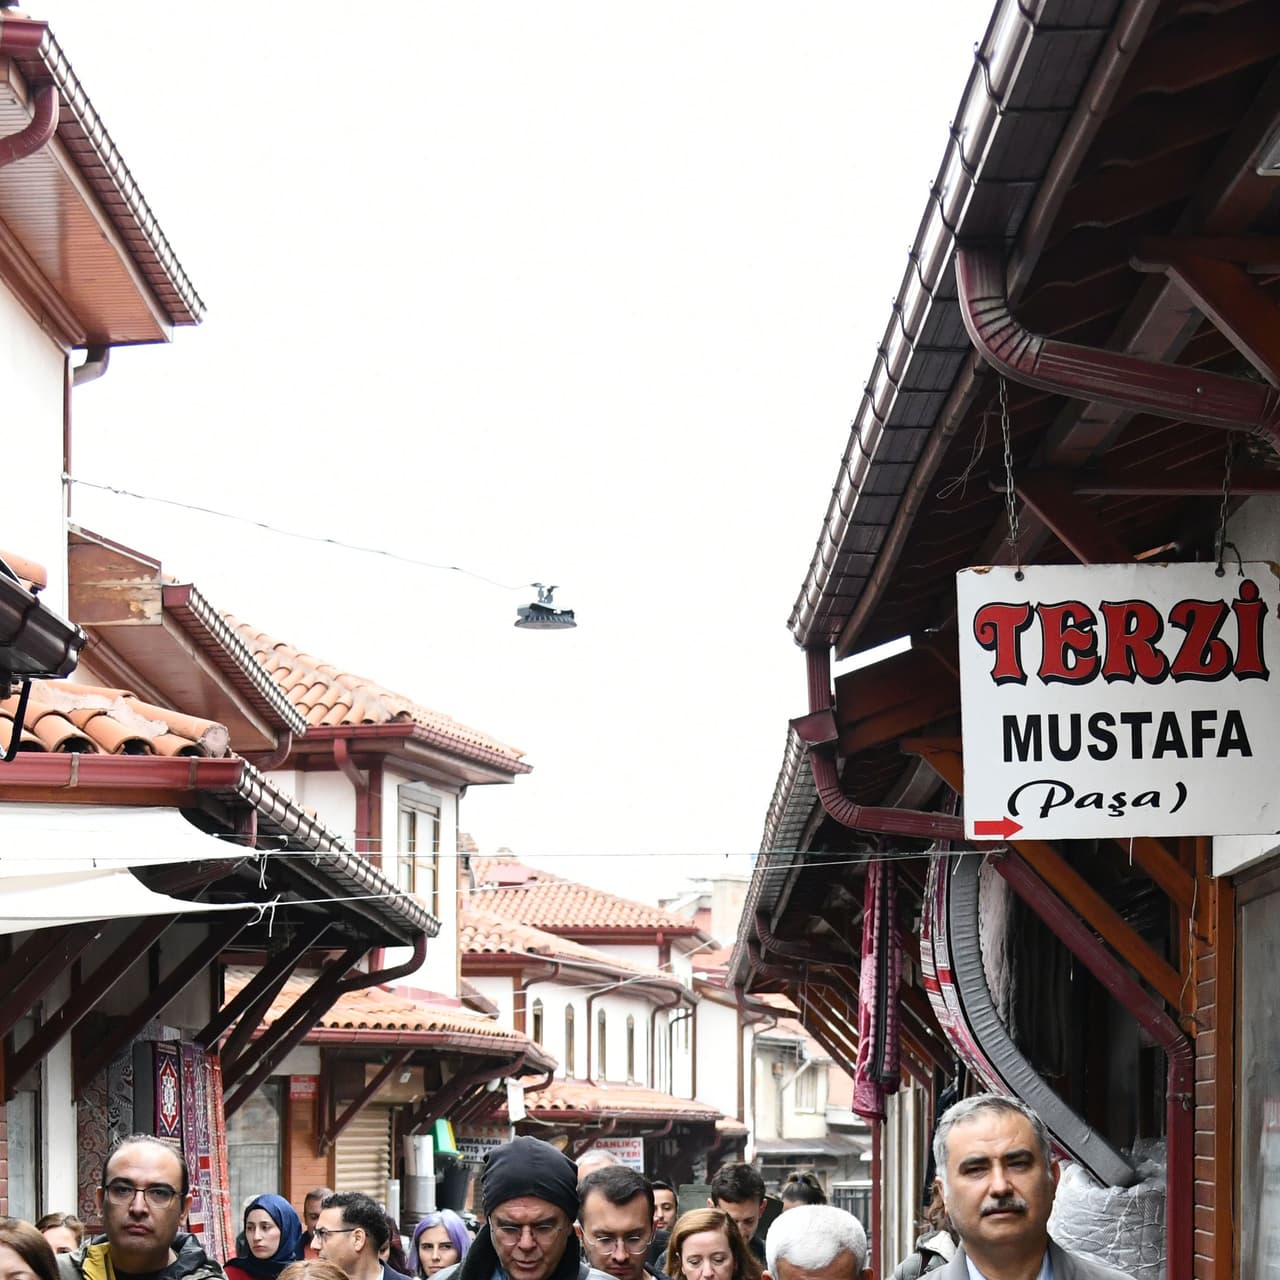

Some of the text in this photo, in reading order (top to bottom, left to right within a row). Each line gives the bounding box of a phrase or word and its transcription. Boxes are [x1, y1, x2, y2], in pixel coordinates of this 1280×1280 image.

[973, 579, 1270, 686] TERZİ
[1002, 710, 1253, 762] MUSTAFA
[1007, 779, 1187, 818] (Paşa)
